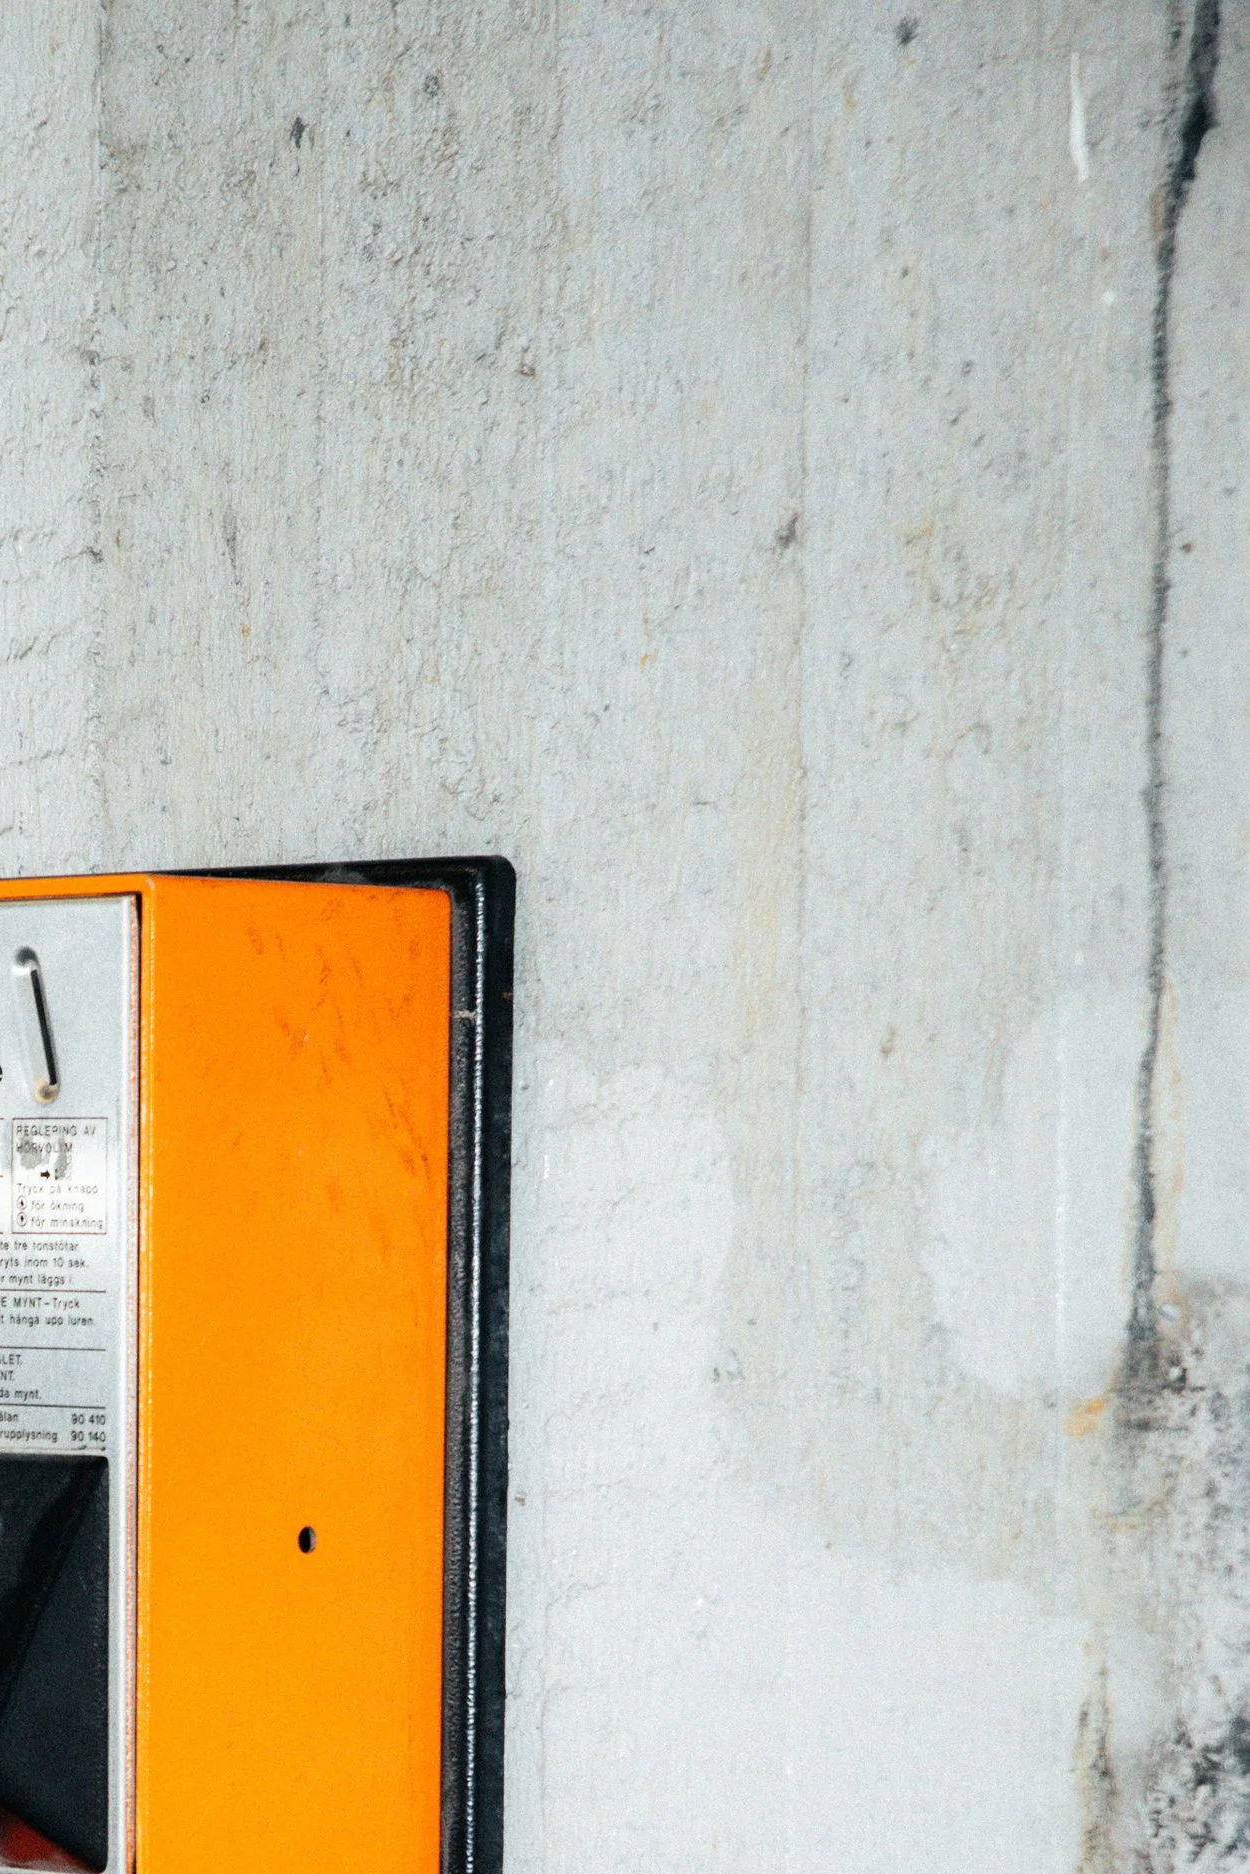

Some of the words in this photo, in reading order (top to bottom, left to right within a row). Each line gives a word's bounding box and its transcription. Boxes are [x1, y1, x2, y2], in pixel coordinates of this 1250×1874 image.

[84, 1126, 96, 1136] AV
[14, 1241, 28, 1251] tre
[24, 1257, 48, 1267] inom
[9, 1274, 34, 1286] mynt
[13, 1297, 42, 1308] MYNT
[52, 1297, 80, 1311] Tryck
[45, 1317, 64, 1327] upp
[71, 1413, 85, 1425] 90
[89, 1414, 106, 1425] 410
[71, 1430, 85, 1442] 90
[88, 1431, 106, 1443] 140
